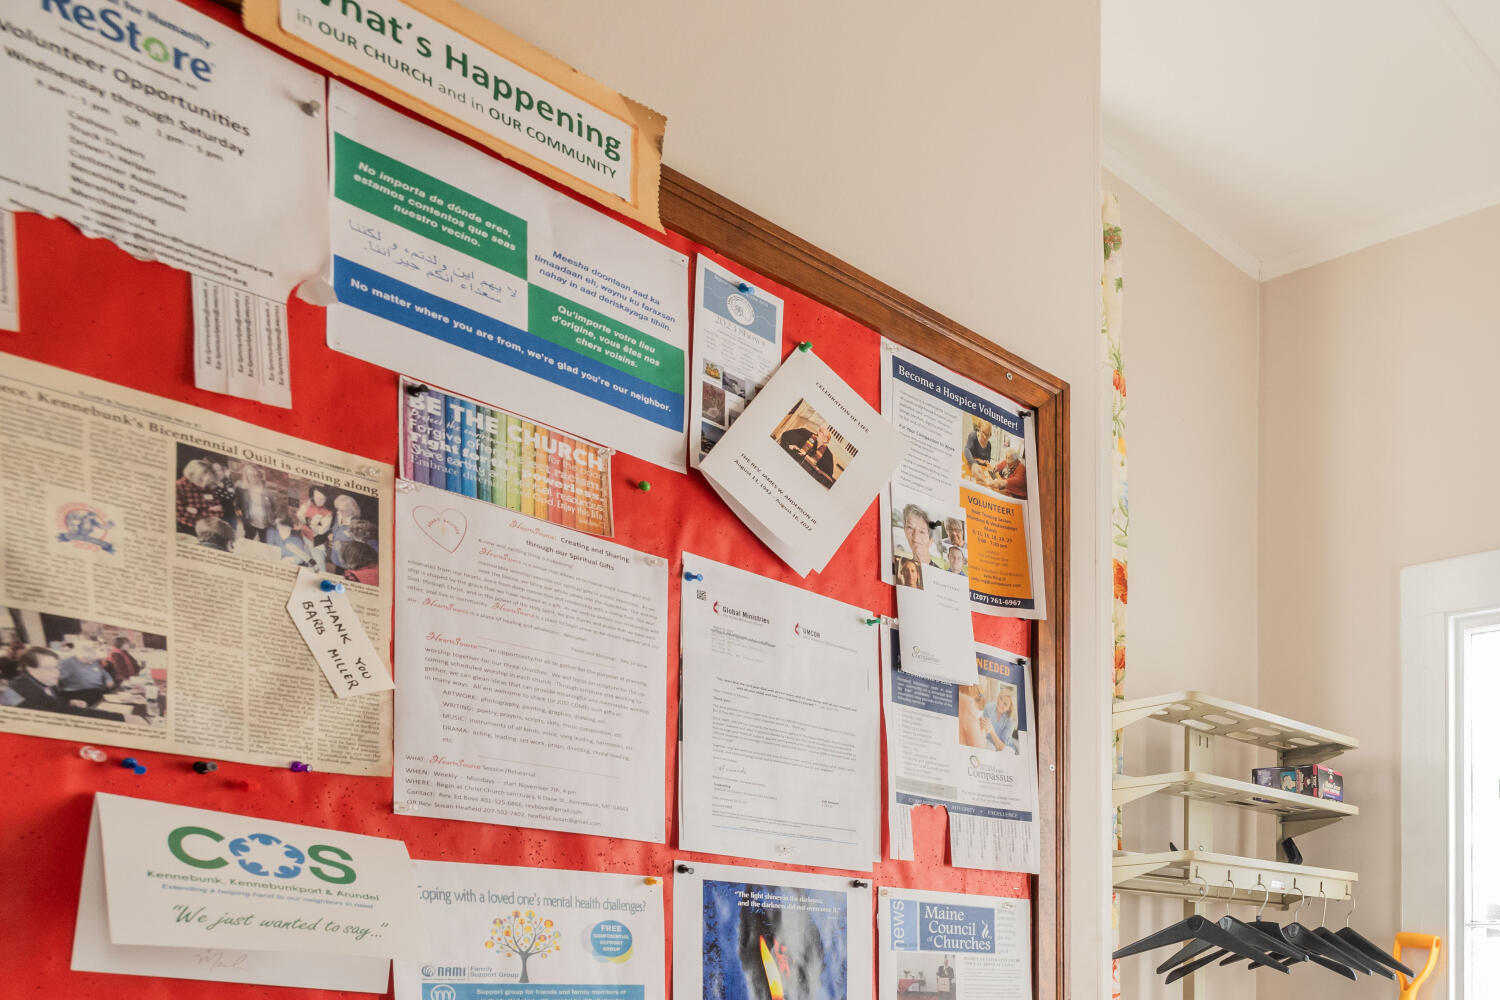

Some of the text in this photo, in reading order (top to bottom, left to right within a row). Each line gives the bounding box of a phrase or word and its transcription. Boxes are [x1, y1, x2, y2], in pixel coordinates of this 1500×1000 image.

[319, 0, 622, 162] hat's Happening
[4, 45, 245, 157] Wednesday through Saturday
[113, 68, 251, 137] Opportunities
[318, 20, 359, 50] OUR
[363, 43, 433, 87] CHURCH
[438, 82, 467, 105] and
[471, 96, 485, 113] in
[489, 106, 522, 133] OUR
[526, 126, 618, 180] COMMUNITY
[353, 172, 516, 251] estamos contentos que seas
[358, 161, 512, 239] No importa de dónde eres,
[393, 204, 481, 248] nuestro vecino.
[539, 267, 568, 287] nahay
[569, 278, 578, 289] in
[580, 285, 597, 299] aad
[552, 250, 589, 272] Meesha
[632, 288, 648, 300] aad
[351, 278, 672, 413] No matter where you are from, we're glad you're our neighbor.
[575, 336, 602, 354] chers
[599, 334, 621, 349] vous
[623, 341, 643, 359] êtes
[644, 354, 660, 367] nos
[614, 328, 637, 346] votre
[639, 339, 656, 354] lieu
[898, 363, 1019, 432] Become a Hospice Volunteer!
[37, 391, 145, 430] Kennebunk's
[149, 421, 239, 457] Bicentennial
[242, 447, 278, 468] Quilt
[281, 455, 292, 470] is
[295, 465, 342, 490] coming
[344, 478, 381, 498] along
[408, 393, 604, 473] BE THE CHURCH
[967, 495, 1015, 517] VOLUNTEER!
[525, 539, 615, 572] through our Spiritual Gifts
[560, 536, 630, 564] Creating and Sharing
[722, 606, 741, 618] Global
[972, 590, 990, 604] (207)
[301, 600, 360, 691] BARB MILLER
[319, 594, 372, 680] THANK YOU
[229, 878, 323, 897] Kennebunkport
[335, 889, 380, 902] Arundel
[418, 885, 647, 915] oping with a loved one's mental health challenges?
[205, 913, 253, 931] just
[260, 916, 319, 932] wanted
[324, 919, 341, 934] to
[600, 923, 623, 933] FREE
[891, 897, 906, 951] news
[924, 905, 965, 921] Maine
[928, 919, 976, 937] Council
[933, 935, 992, 951] Churches
